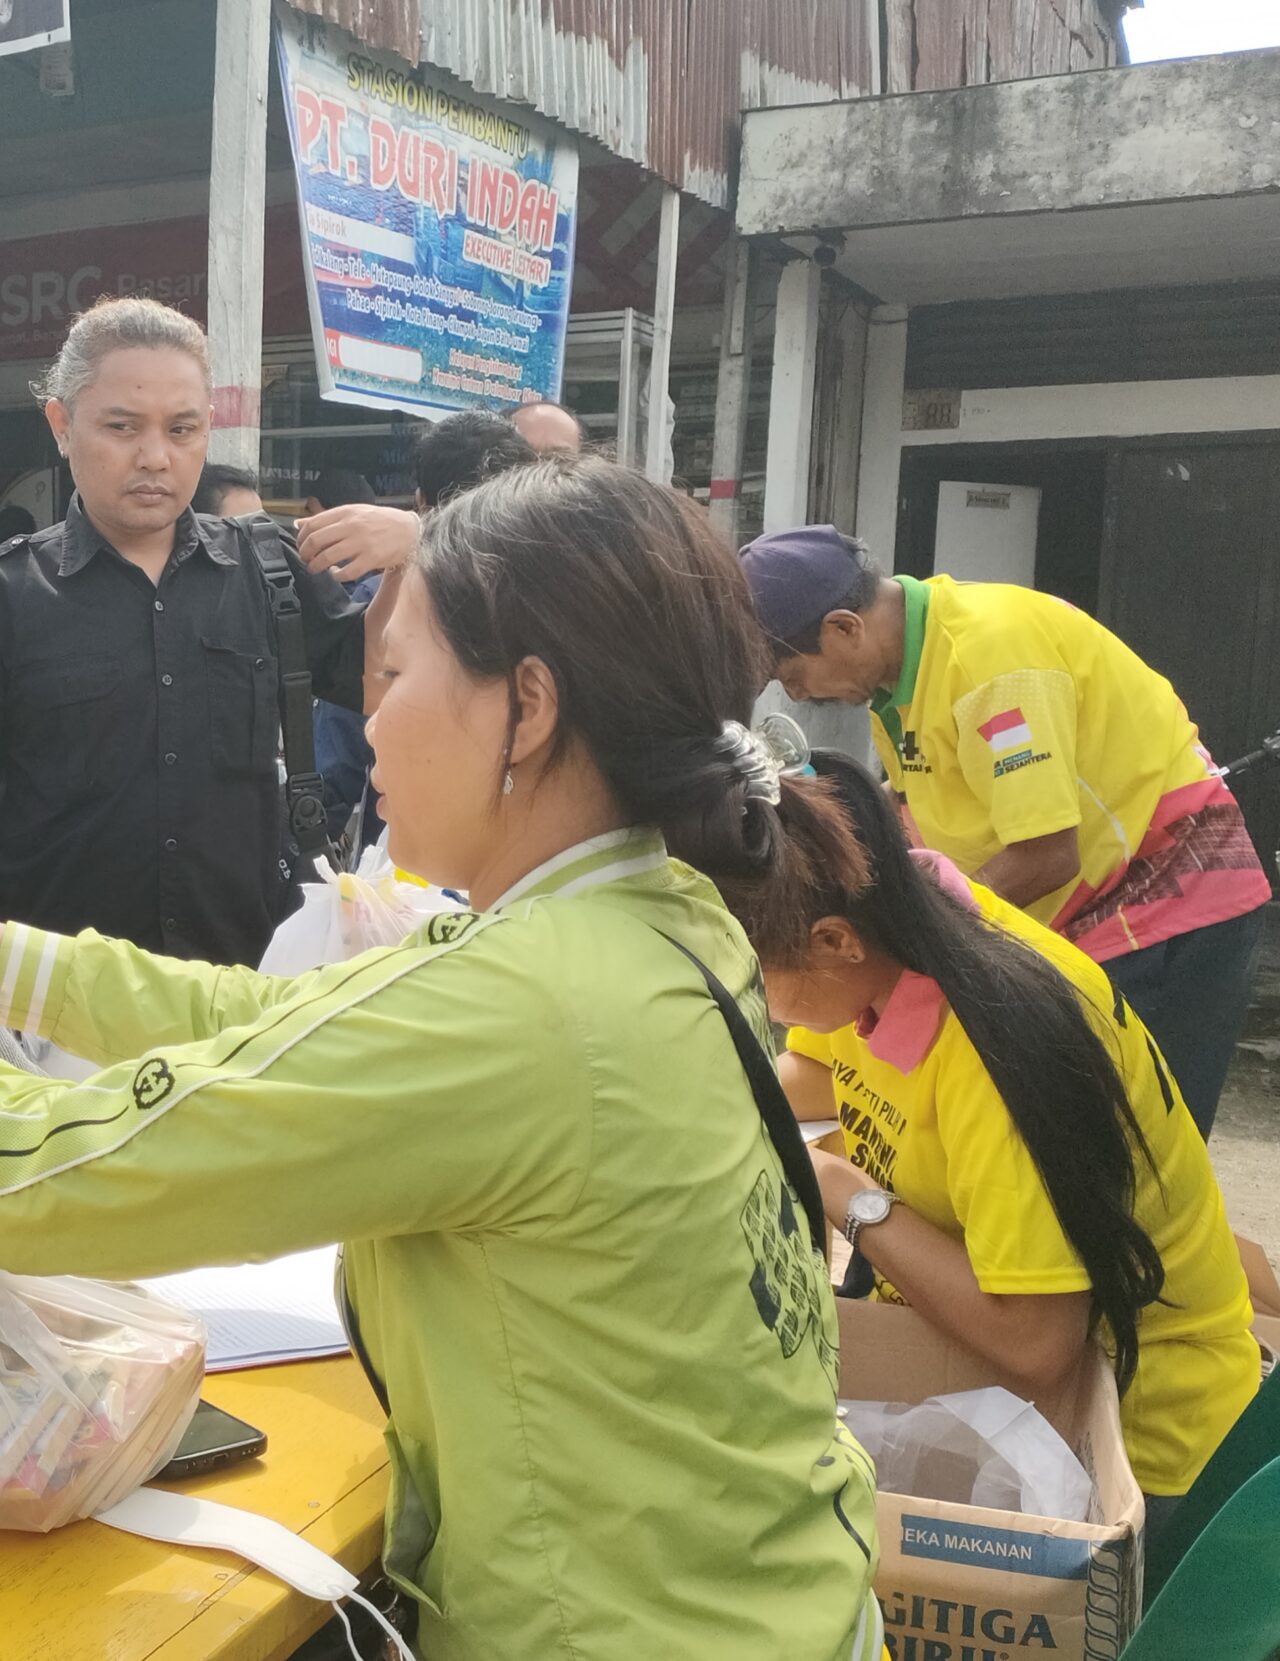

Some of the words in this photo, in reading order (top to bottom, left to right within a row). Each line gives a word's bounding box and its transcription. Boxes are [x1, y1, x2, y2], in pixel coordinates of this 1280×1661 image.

[346, 52, 433, 116] STASION
[434, 88, 531, 161] PEMBANTU
[294, 83, 359, 183] PT.
[369, 115, 459, 221] DURI
[466, 154, 558, 252] INDAH
[464, 233, 513, 271] EXECUTIVE
[1, 265, 103, 326] SRC
[904, 1527, 940, 1547] EKA
[943, 1533, 1033, 1561] MAKANAN
